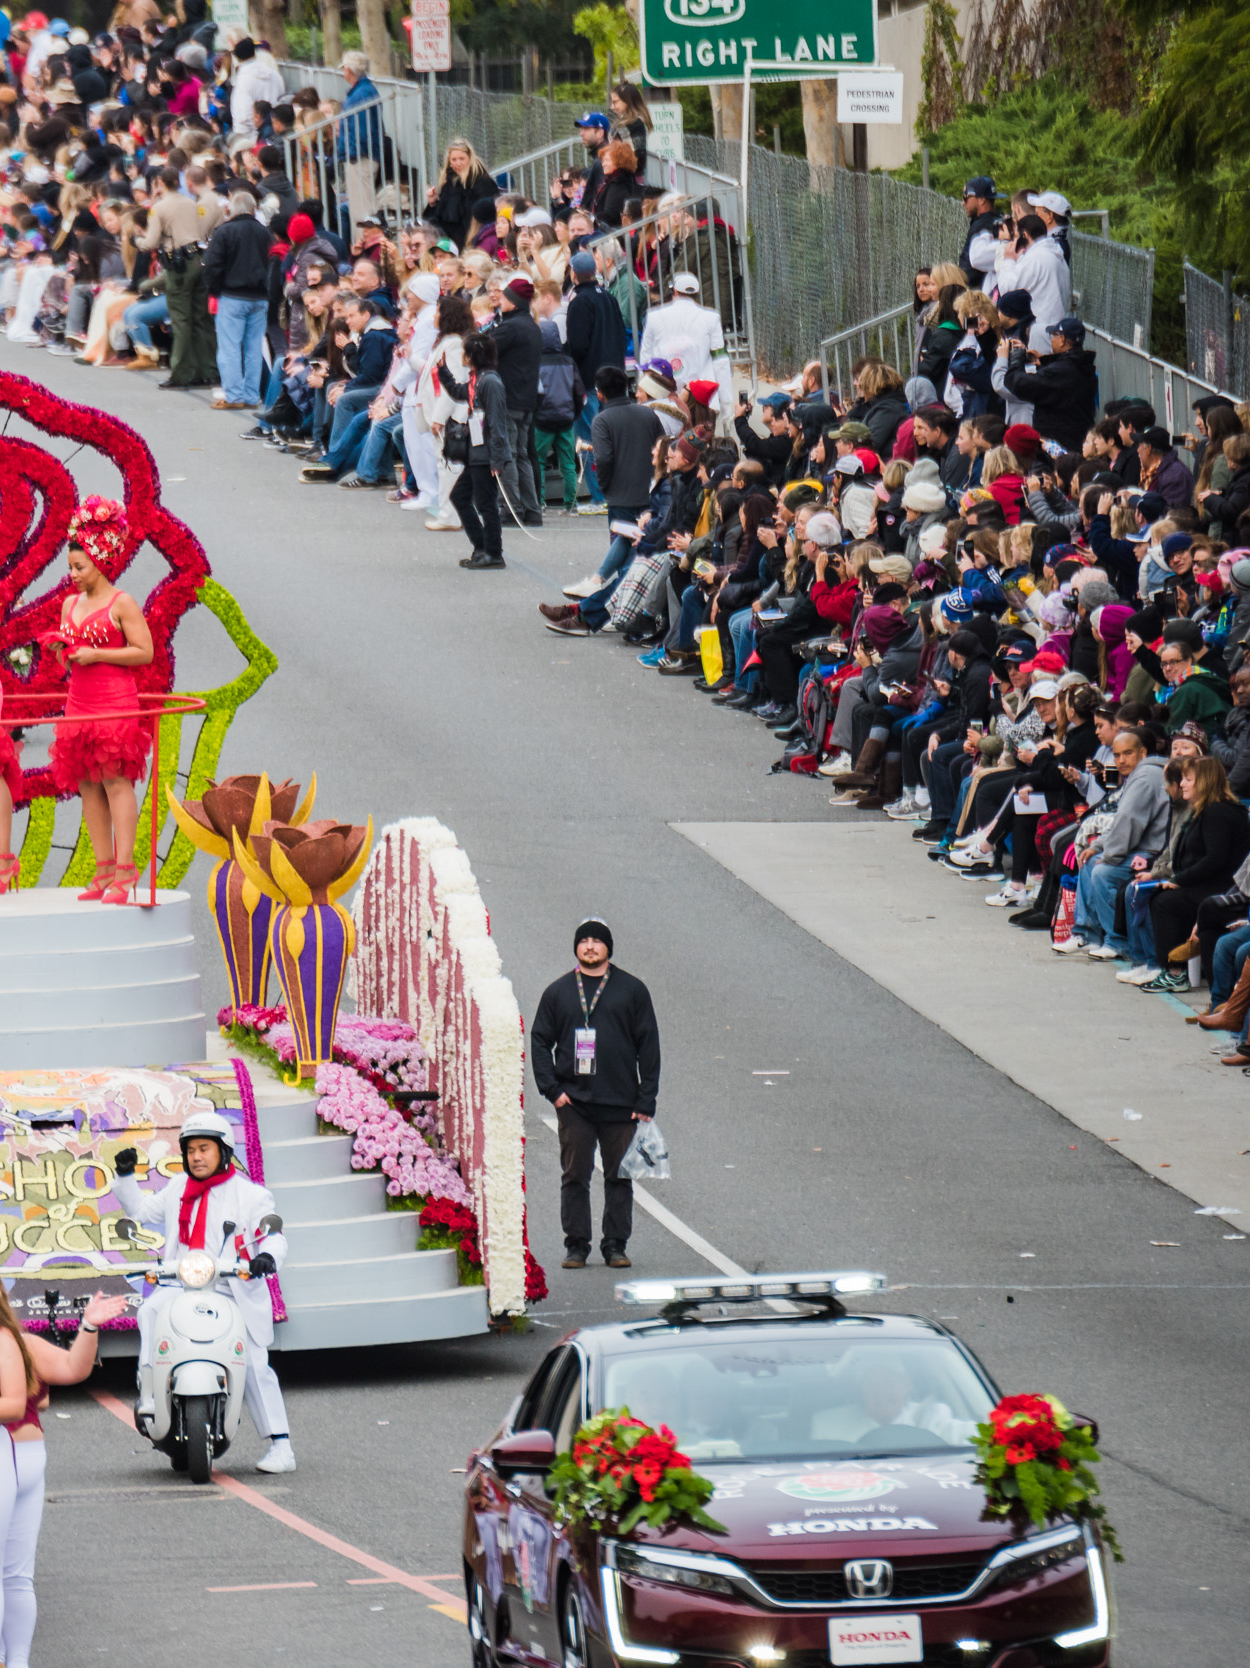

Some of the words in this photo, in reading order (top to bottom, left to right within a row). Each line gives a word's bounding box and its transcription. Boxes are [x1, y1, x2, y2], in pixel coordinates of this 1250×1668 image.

[416, 2, 446, 12] BEGIN
[661, 37, 758, 68] RIGHT
[774, 32, 859, 62] LANE
[846, 89, 895, 99] PEDESTRIAN
[850, 104, 890, 113] CROSSING
[654, 111, 675, 120] TURN
[661, 136, 670, 146] TO
[48, 1198, 84, 1223] of
[804, 1504, 875, 1517] presented
[879, 1503, 899, 1514] by
[766, 1516, 939, 1537] HONDA
[838, 1631, 912, 1644] HONDA
